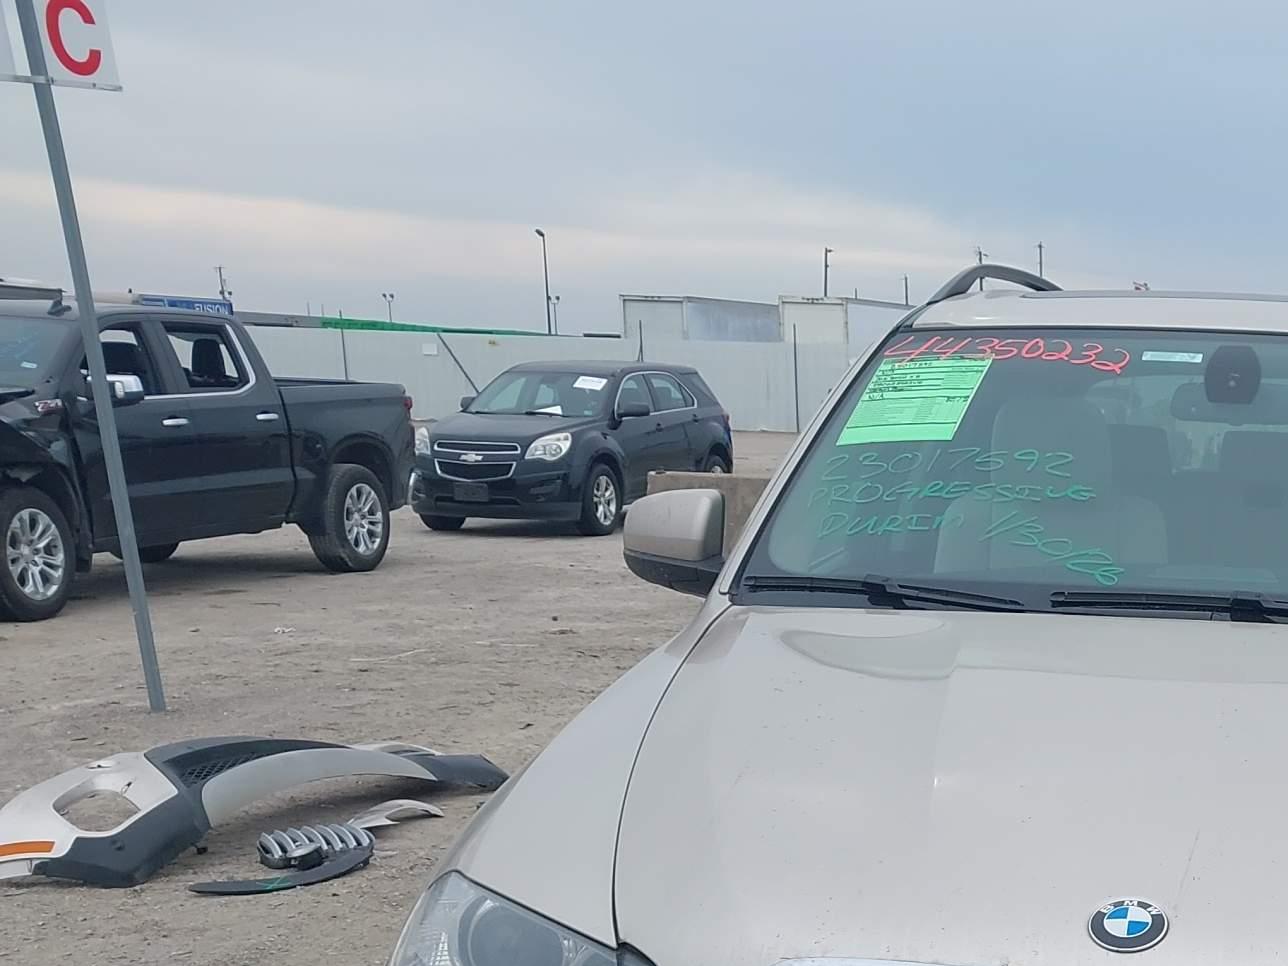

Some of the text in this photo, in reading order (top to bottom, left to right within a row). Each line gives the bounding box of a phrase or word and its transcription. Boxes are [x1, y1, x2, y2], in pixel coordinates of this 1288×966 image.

[46, 0, 101, 76] C
[884, 336, 1130, 374] 44350232
[822, 448, 1073, 480] 23017592
[1100, 900, 1161, 914] BMW
